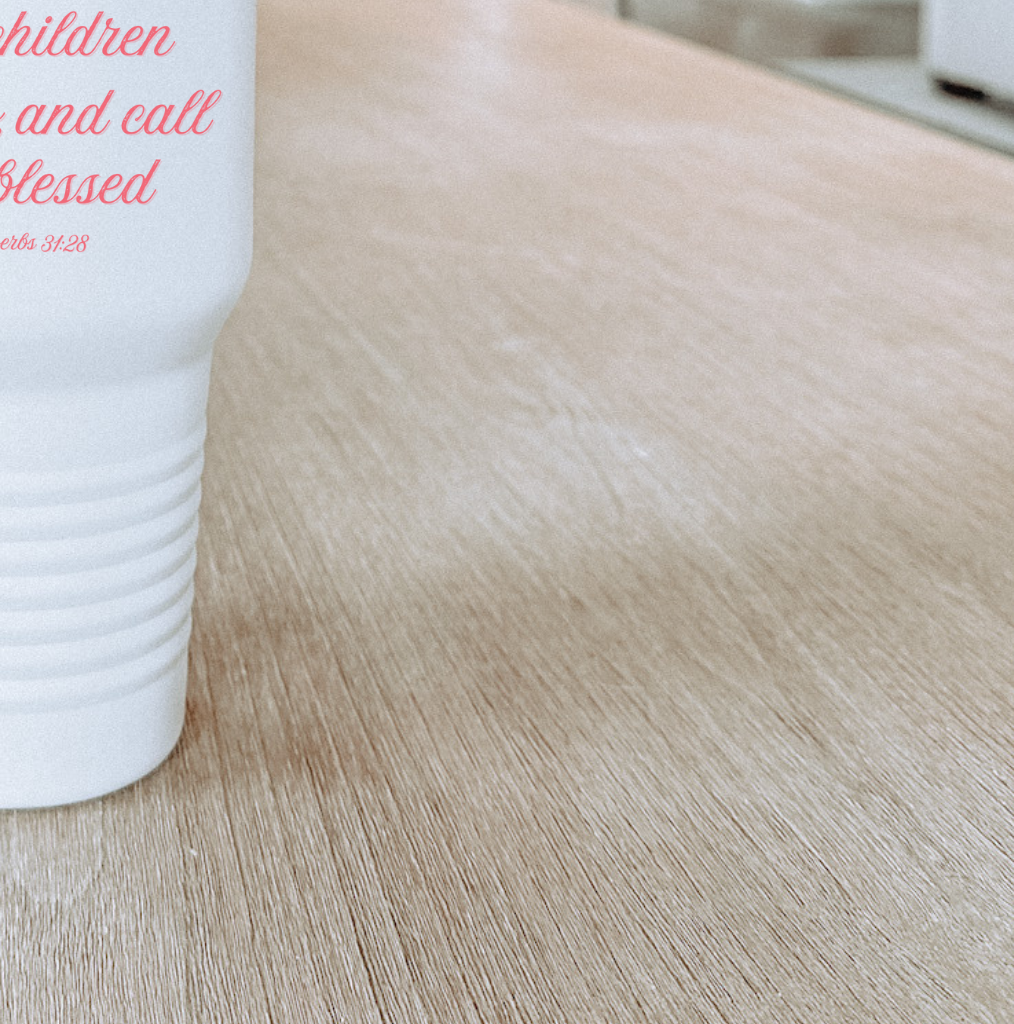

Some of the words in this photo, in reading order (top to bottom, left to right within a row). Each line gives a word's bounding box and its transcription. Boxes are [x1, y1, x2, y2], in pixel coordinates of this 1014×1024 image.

[15, 90, 114, 135] and
[121, 90, 222, 134] call
[41, 235, 89, 252] 31:28
